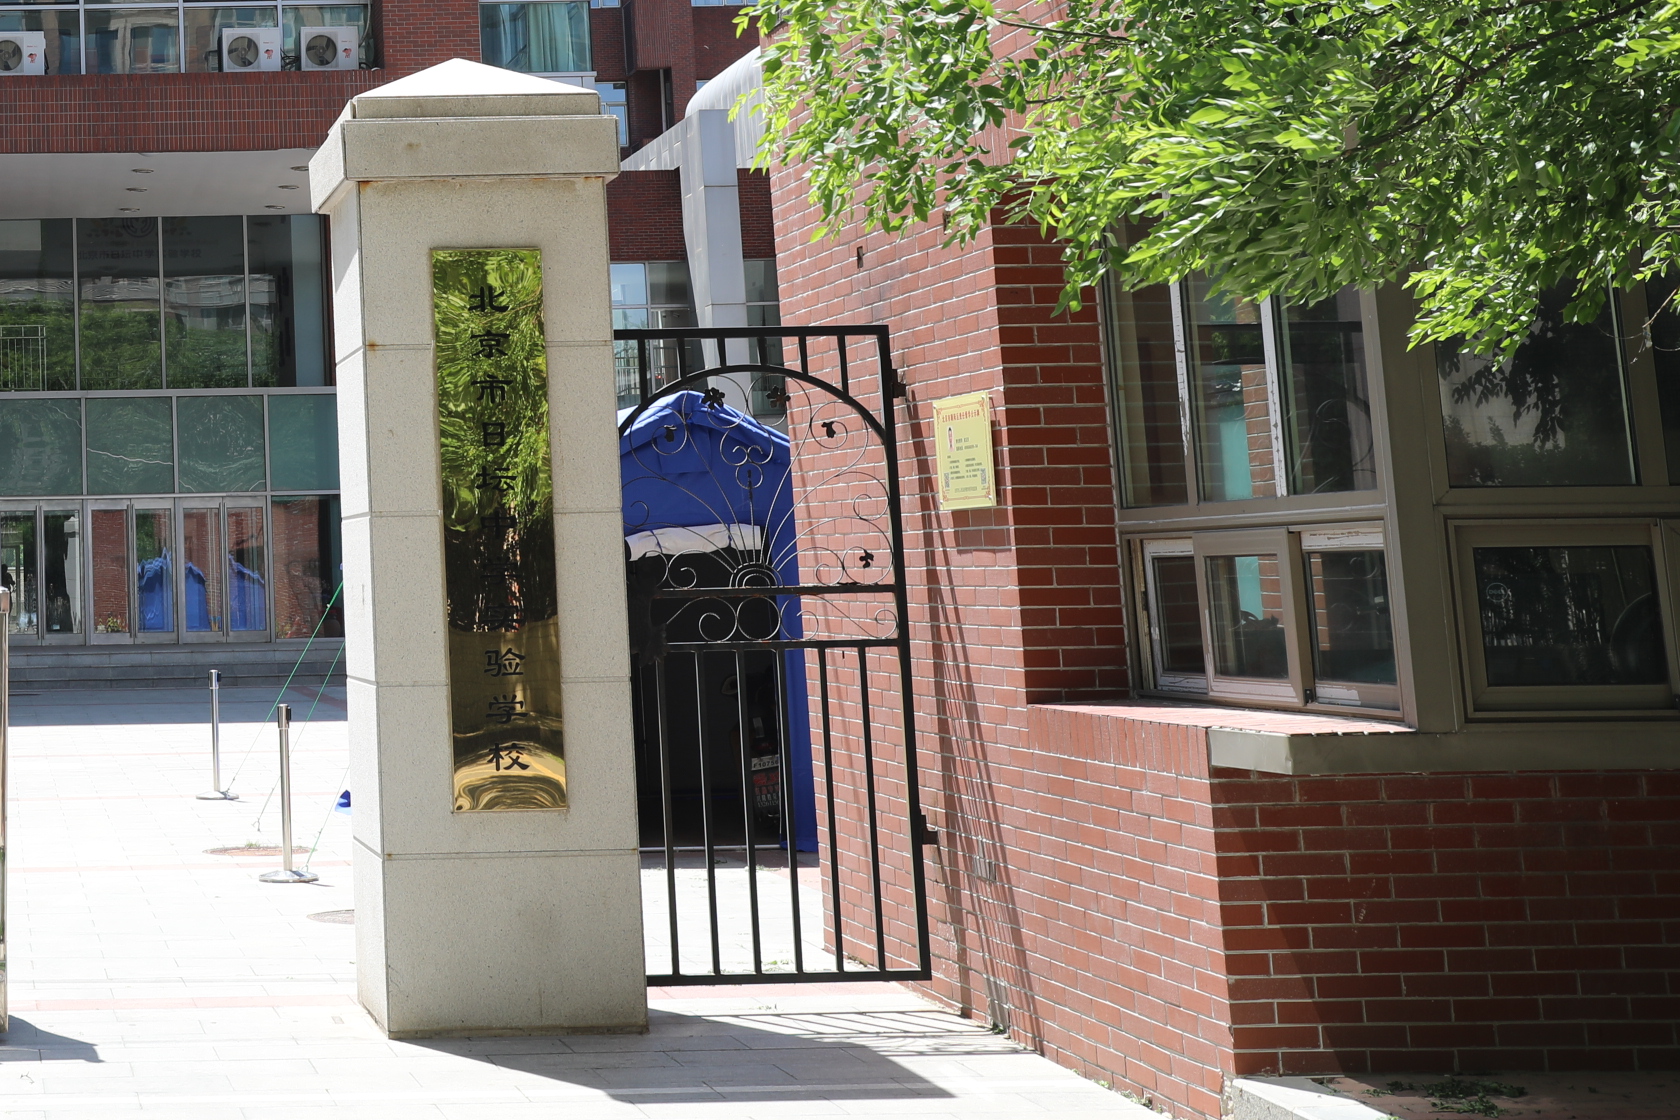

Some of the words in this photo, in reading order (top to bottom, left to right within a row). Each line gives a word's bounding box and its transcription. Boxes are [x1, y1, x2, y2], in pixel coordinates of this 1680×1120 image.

[468, 285, 531, 772] 北京市日坛中学实验学校
